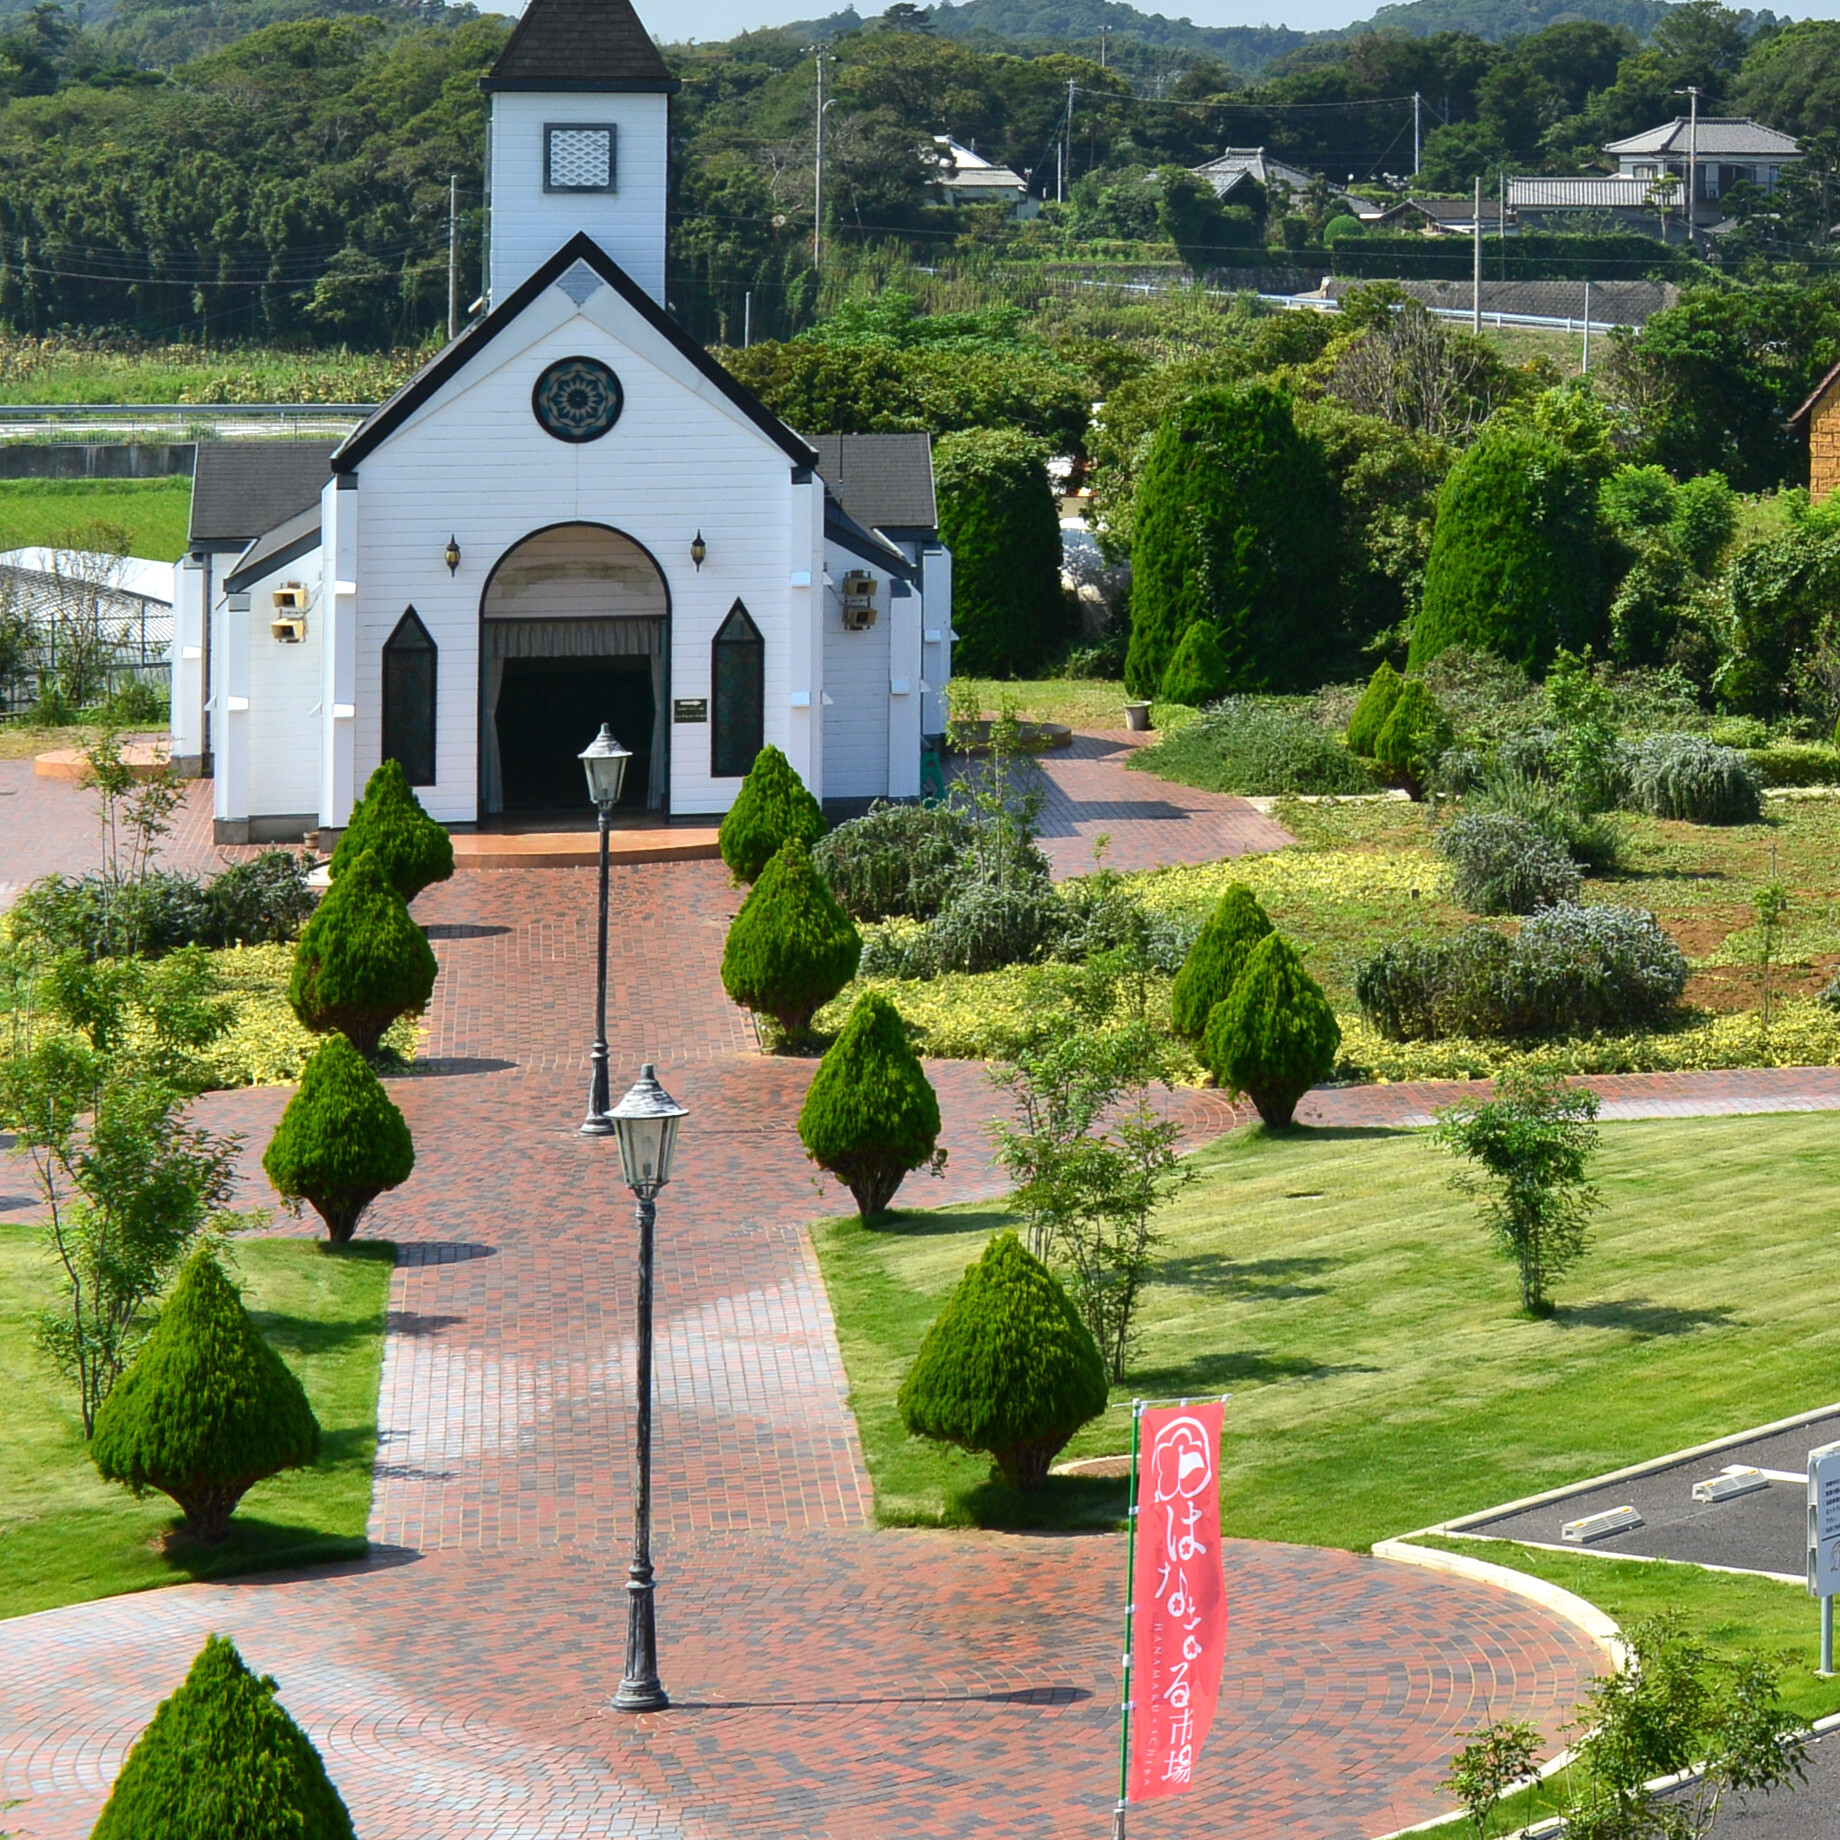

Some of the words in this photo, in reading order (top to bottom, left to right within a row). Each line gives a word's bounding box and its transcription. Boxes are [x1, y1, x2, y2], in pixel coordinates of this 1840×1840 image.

[1154, 1500, 1207, 1785] はなまる市場
